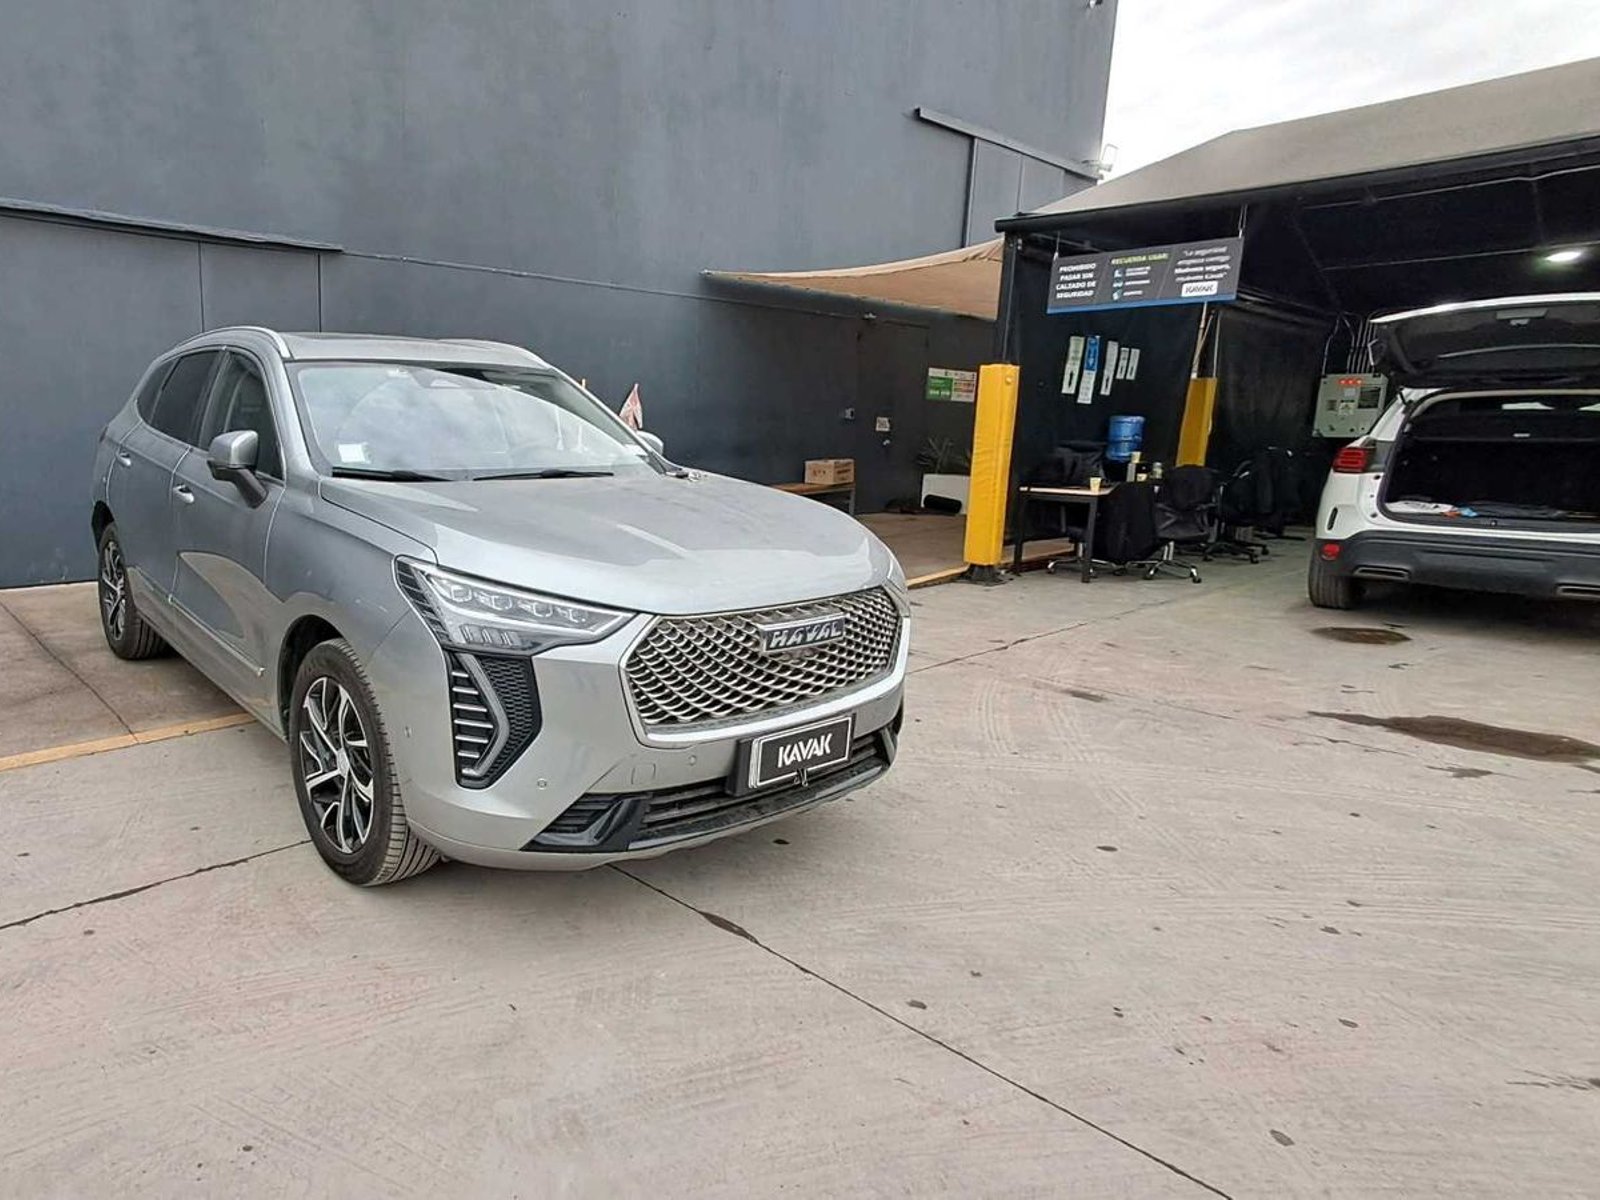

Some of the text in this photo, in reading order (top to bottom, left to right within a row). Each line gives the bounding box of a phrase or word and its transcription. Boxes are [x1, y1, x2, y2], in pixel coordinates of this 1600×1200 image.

[1059, 263, 1097, 272] PROHIBIDO
[1060, 272, 1094, 281] PASAR SIN
[1056, 281, 1087, 290] CALZADO
[1185, 284, 1214, 294] KAVAK
[1056, 290, 1094, 299] SEGURIDAD
[769, 621, 842, 649] HAVAL
[777, 732, 833, 769] KAVAK
